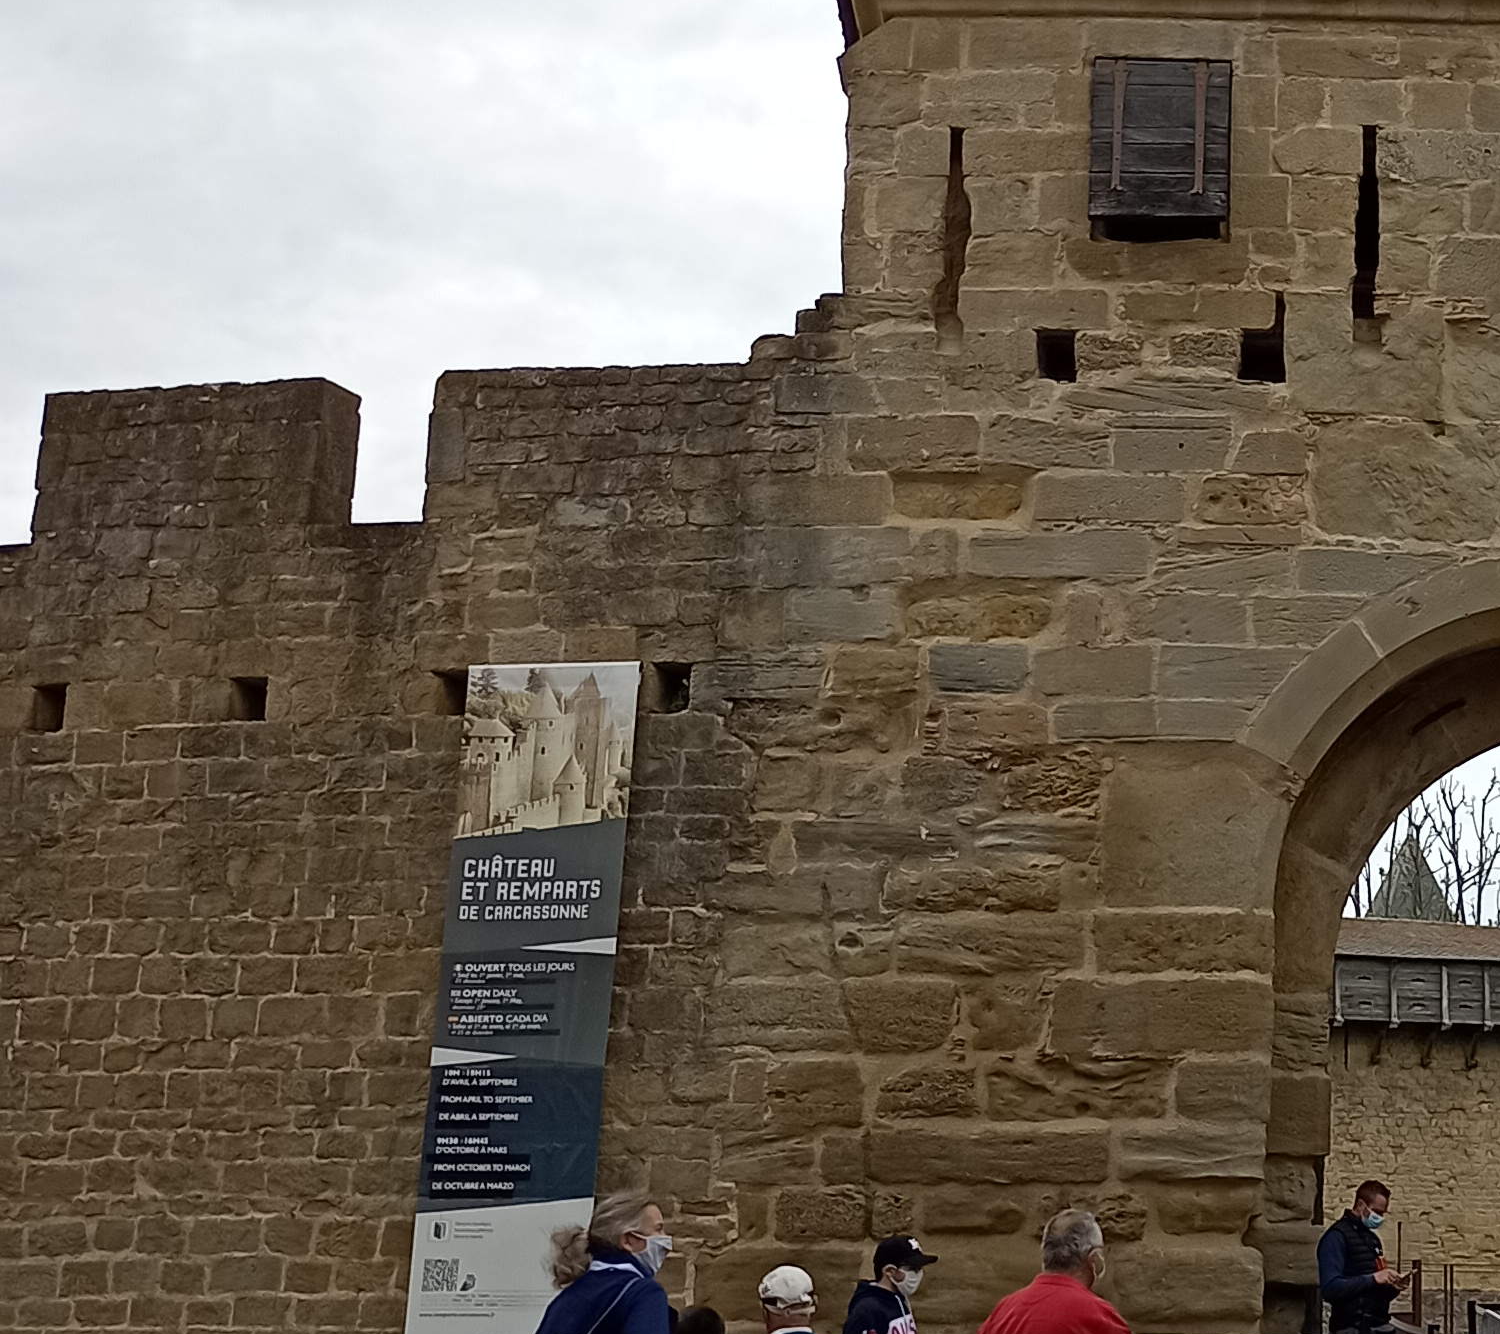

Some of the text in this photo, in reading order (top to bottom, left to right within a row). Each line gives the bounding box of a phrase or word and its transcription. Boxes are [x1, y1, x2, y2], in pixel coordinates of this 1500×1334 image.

[463, 854, 555, 878] CHÂTEAU
[461, 879, 601, 901] ET REMPARTS
[459, 903, 589, 920] DE CARCASSONNE
[465, 962, 575, 973] OUVERT TOUS LES JOURS
[462, 989, 518, 998] OPEN DAILY
[460, 1015, 503, 1023] ABIERTO
[505, 1014, 531, 1022] CADA
[479, 1078, 518, 1086] SEPTEMBRE
[440, 1095, 462, 1103] FROM
[462, 1095, 482, 1103] APRIL
[431, 1182, 443, 1190] DE
[486, 1182, 515, 1190] MARZO
